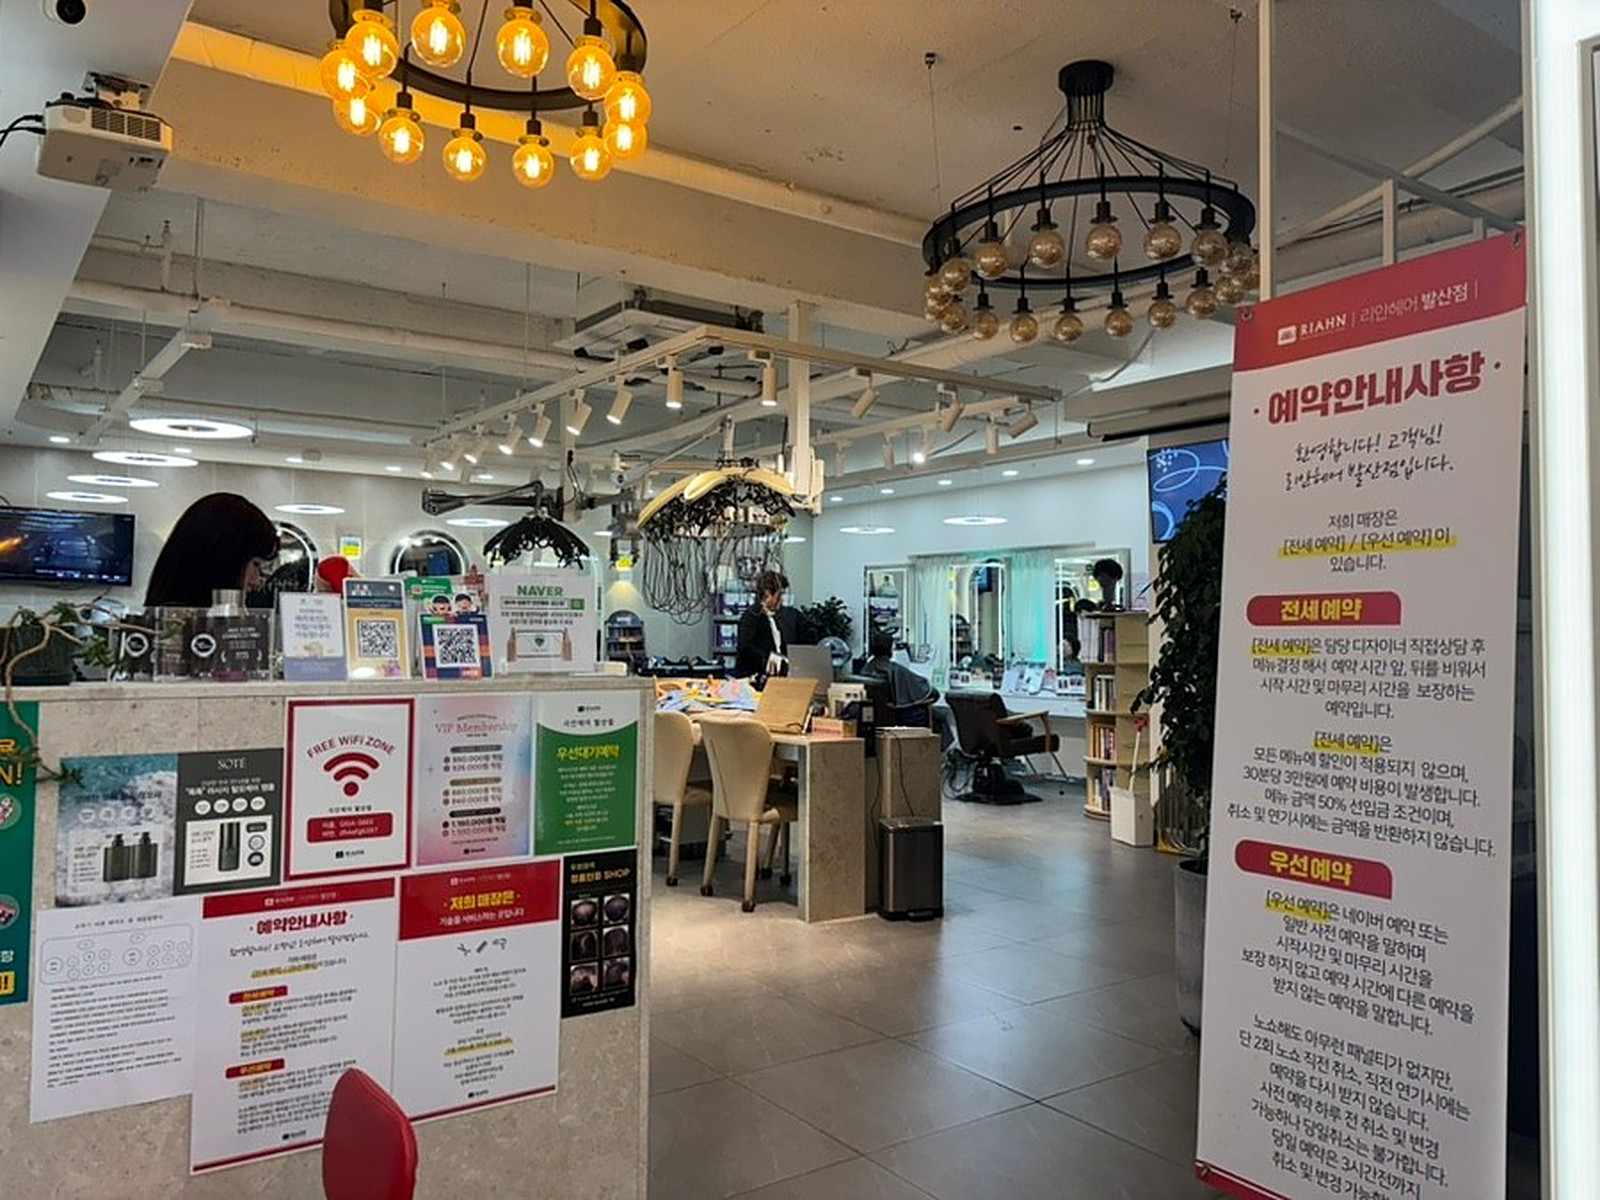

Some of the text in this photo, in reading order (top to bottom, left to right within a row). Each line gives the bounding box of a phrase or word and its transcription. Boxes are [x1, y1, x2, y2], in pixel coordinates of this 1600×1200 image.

[1421, 283, 1467, 310] 발산점
[1300, 314, 1346, 335] RIAHN
[1268, 351, 1484, 424] 예약안내사항
[1388, 423, 1442, 450] 고객님!
[1328, 509, 1397, 530] 저희 매장은
[1361, 531, 1394, 551] [우선
[1329, 554, 1386, 572] 있습니다.
[517, 584, 564, 597] NAVER
[1281, 600, 1362, 620] 전세예약
[1324, 638, 1350, 655] 담당
[1352, 638, 1406, 655] 디자이너
[1409, 638, 1467, 656] 직접상담
[1470, 638, 1485, 655] 후
[1303, 658, 1326, 674] 해서
[1331, 659, 1356, 675] 예약
[1360, 659, 1386, 676] 시간
[1410, 660, 1438, 677] 뒤를
[1442, 661, 1485, 678] 비워서
[1260, 677, 1283, 693] 시작
[1313, 679, 1325, 695] 및
[1327, 679, 1366, 696] 마무리
[1369, 681, 1410, 699] 시간을
[1416, 683, 1474, 701] 보장하는
[1325, 700, 1394, 719] 예약입니다.
[306, 734, 397, 759] FREE WiFi ZONE
[1254, 747, 1468, 783] 모든 메뉴에 할인이 적용되지 않으며,
[1242, 766, 1479, 807] 30분당 3만원에 예약 비용이 발생합니다.
[1264, 788, 1288, 805] 메뉴
[1292, 791, 1315, 809] 금액
[1318, 795, 1346, 811] 50%
[1349, 799, 1389, 819] 선입금
[1226, 803, 1495, 857] 취소 및 연기시에는 금액을 반환하지 않습니다.
[1269, 852, 1352, 884] 우선예약
[450, 890, 515, 910] 저희 매장은
[256, 910, 347, 934] 예약안내사항
[1342, 907, 1383, 931] 네이버
[1386, 917, 1414, 937] 예약
[1418, 923, 1448, 945] 또는
[1282, 916, 1425, 963] 일반 사전 예약을 말하며
[1328, 947, 1341, 966] 및
[1344, 952, 1385, 977] 마무리
[1388, 964, 1432, 989] 시간을
[1241, 948, 1265, 967] 보장
[1294, 961, 1320, 981] 않고
[1322, 969, 1349, 990] 예약
[1352, 977, 1393, 1002] 시간에
[1396, 988, 1426, 1011] 다른
[1429, 997, 1473, 1023] 예약을
[1272, 977, 1433, 1036] 받지 않는 예약을 말합니다.
[1253, 1014, 1453, 1092] 노쇼해도 아무런 패널티가 없지만,
[1238, 1030, 1251, 1048] 단
[1253, 1036, 1273, 1055] 2회
[1275, 1043, 1300, 1063] 노쇼
[1303, 1051, 1329, 1074] 직전
[1365, 1071, 1392, 1096] 직전
[1395, 1081, 1470, 1121] 연기시에는
[1270, 1062, 1429, 1131] 예약을 다시 받지 않습니다.
[1260, 1082, 1438, 1160] 사전 예약 하루 전 취소 및 변경
[1251, 1099, 1448, 1187] 가능하나 당일취소는 불가합니다.
[1272, 1128, 1419, 1200] 당일 예약은 3시간전까지
[1272, 1151, 1297, 1173] 취소
[1299, 1161, 1312, 1181] 및
[1315, 1168, 1341, 1192] 변경
